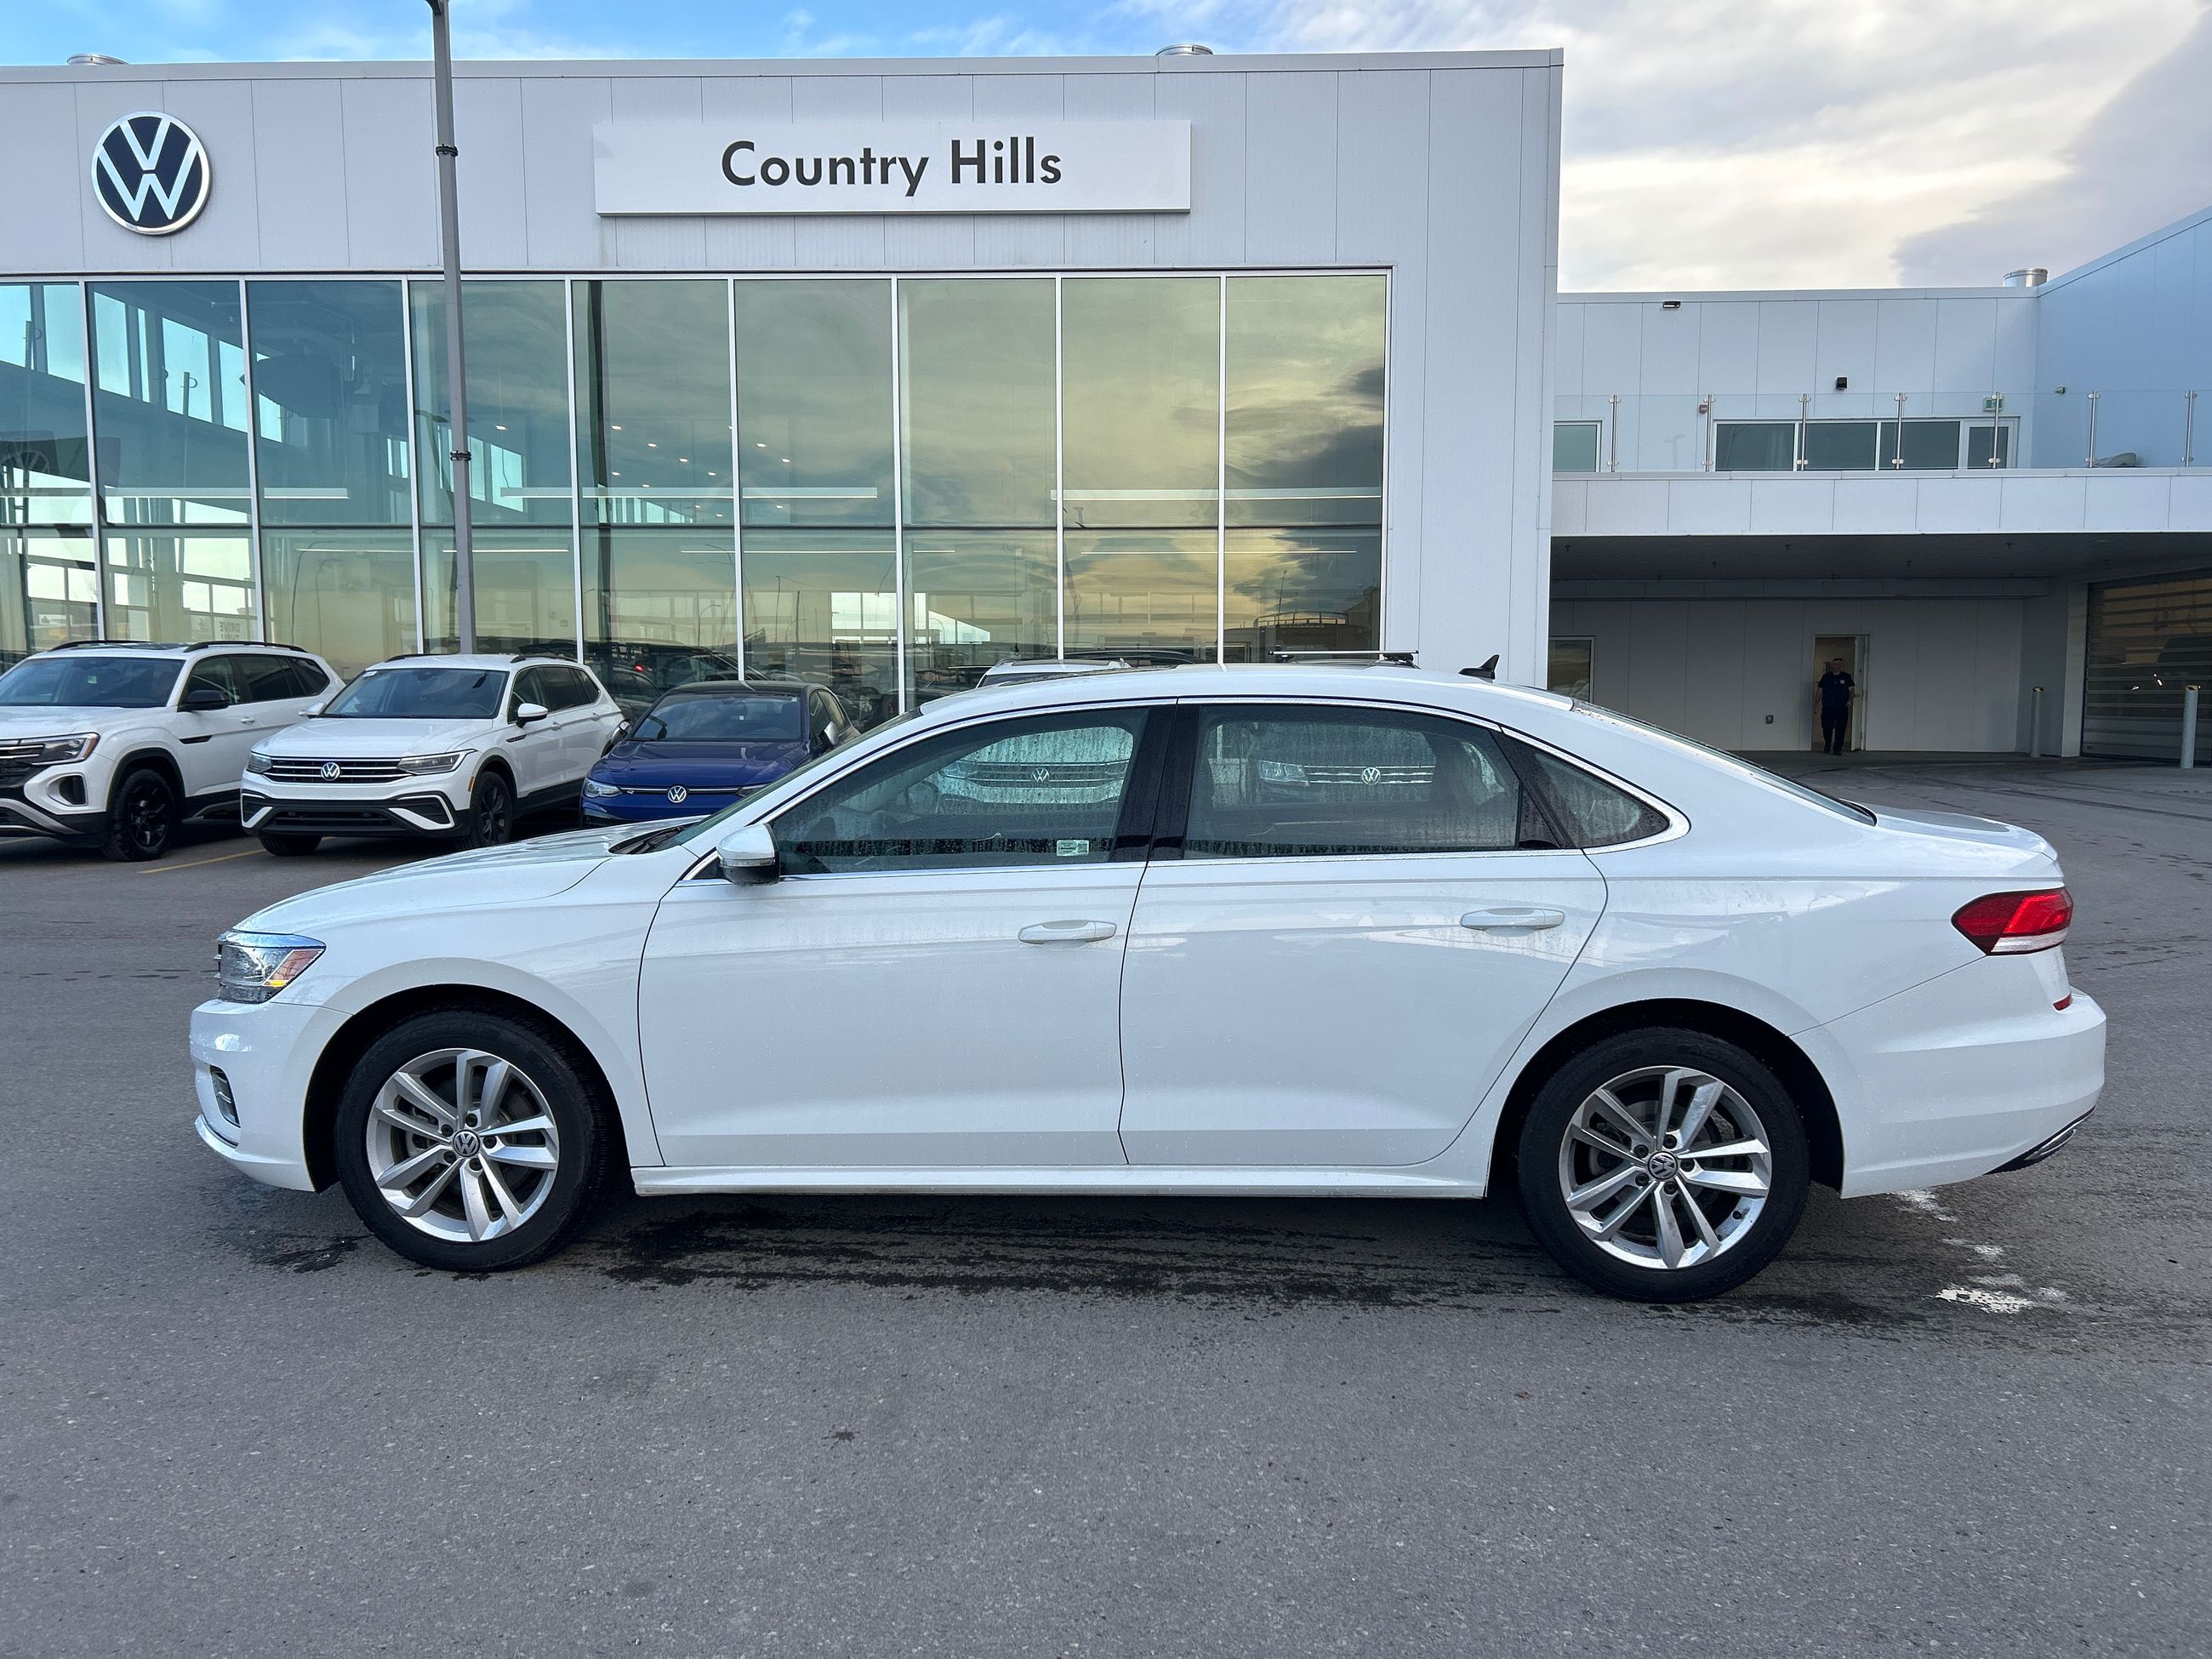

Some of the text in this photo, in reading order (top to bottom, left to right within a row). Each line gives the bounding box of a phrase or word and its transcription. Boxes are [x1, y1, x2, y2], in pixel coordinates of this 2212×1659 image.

[94, 114, 206, 225] VW
[721, 136, 1062, 197] Country Hills
